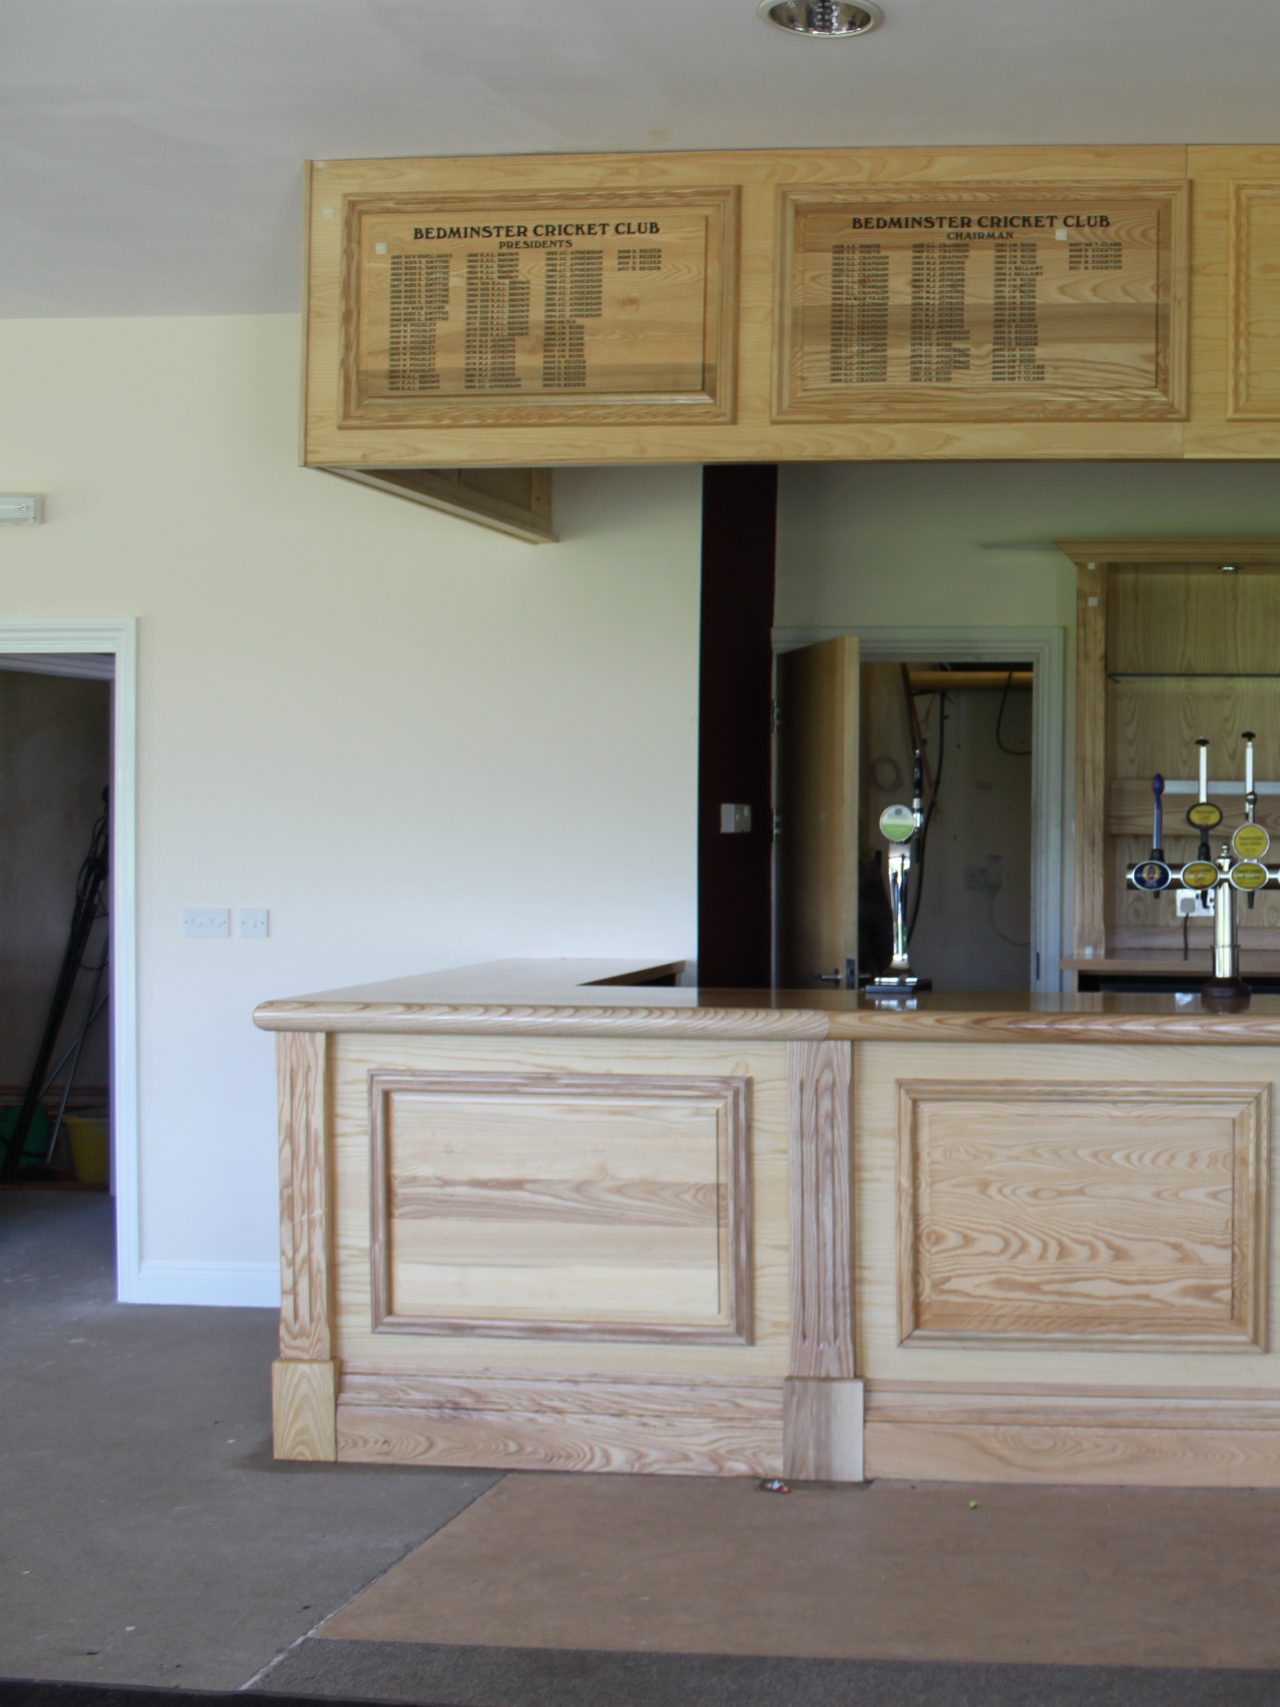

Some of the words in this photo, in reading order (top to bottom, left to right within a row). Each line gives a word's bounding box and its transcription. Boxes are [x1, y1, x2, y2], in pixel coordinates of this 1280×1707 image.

[852, 216, 972, 229] BEDMINSTER
[976, 215, 1058, 228] CRICKET
[1062, 215, 1110, 228] CLUB
[413, 225, 528, 240] BEDMINSTER
[532, 223, 610, 237] CRICKET
[614, 222, 660, 235] CLUB
[946, 231, 1014, 240] CHAIRMAN
[499, 239, 573, 249] PRESIDENTS
